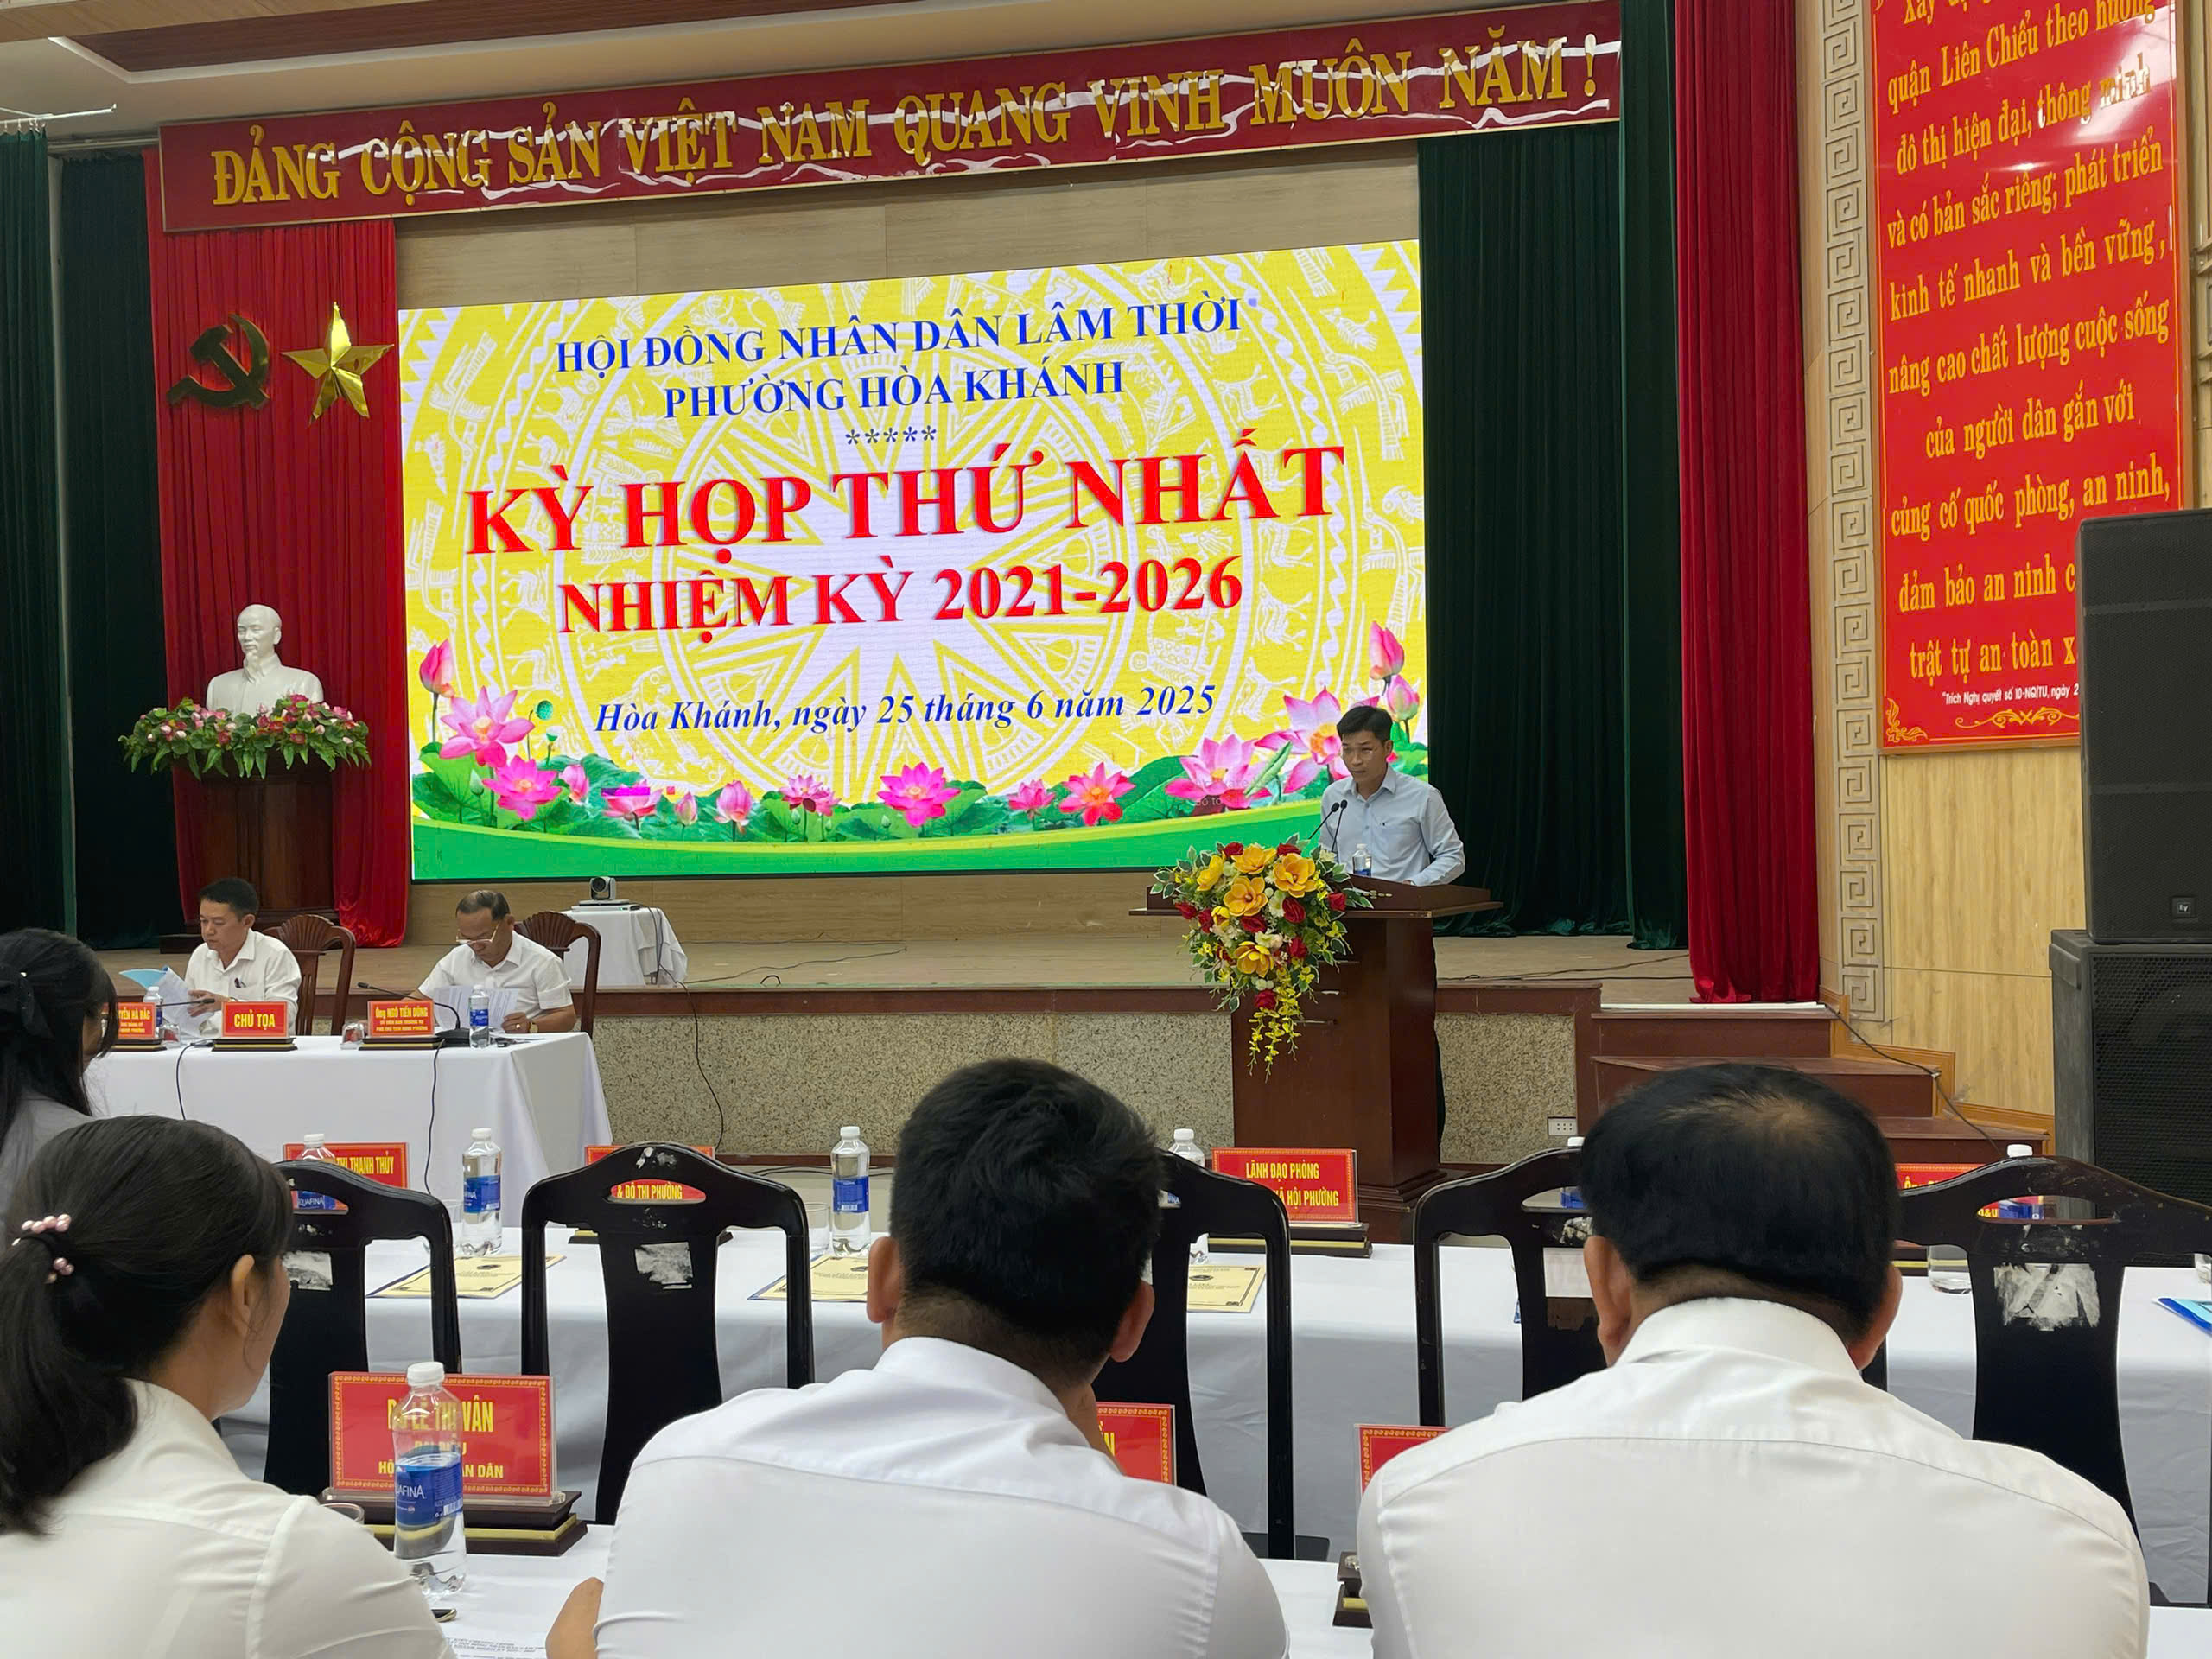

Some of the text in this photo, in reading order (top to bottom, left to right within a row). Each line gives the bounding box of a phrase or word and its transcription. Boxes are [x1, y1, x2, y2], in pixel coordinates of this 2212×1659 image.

[1887, 60, 1931, 115] quận
[1941, 41, 1980, 87] Liên
[1986, 10, 2039, 69] Chiểu
[2046, 3, 2088, 47] theo
[212, 124, 341, 207] ĐẢNG
[360, 120, 493, 207] CỘNG
[508, 101, 603, 183] SẢN
[619, 97, 738, 188] VIỆT
[757, 99, 872, 163] NAM
[893, 81, 1071, 167] QUANG
[1087, 69, 1227, 141] VINH
[1248, 37, 1414, 127] MUÔN
[1897, 53, 2152, 175] đô thị hiện đại, thông minh
[1887, 210, 1906, 249] và
[1910, 202, 1928, 242] có
[1934, 188, 1966, 236] bản
[1972, 173, 2000, 225] sắc
[2064, 146, 2107, 208] phát
[2113, 126, 2164, 184] triển
[1890, 273, 1930, 321] kinh
[1938, 263, 1959, 309] tế
[1963, 248, 2021, 302] nhanh
[2030, 243, 2051, 284] và
[2060, 227, 2097, 276] bền
[555, 290, 1242, 378] HỘI ĐỒNG NHÂN DÂN LÂM THỜI
[1889, 289, 2170, 397] nâng cao chất lượng cuộc sống
[664, 356, 1126, 419] PHƯỜNG HÒA KHÁNH
[1925, 378, 2134, 460] của người dân gắn với
[464, 427, 1345, 565] KỲ HỌP THỨ NHẤT
[1891, 452, 2171, 541] củng cố quốc phòng, an ninh,
[557, 554, 1244, 644] NHIỆM KỲ 2021-2026
[1899, 568, 1936, 613] đảm
[1945, 563, 1975, 608] bảo
[1984, 569, 2005, 602] an
[2013, 553, 2057, 599] ninh
[1910, 628, 2076, 687] trật tự an toàn x
[594, 684, 1217, 735] Hòa Khánh, ngày 25 tháng 6 năm 2025
[2051, 684, 2071, 701] ngày
[234, 1009, 276, 1030] CHỦ TỌA
[651, 1181, 683, 1200] PHƯỜNG
[1246, 1159, 1320, 1182] LÃNH ĐẠO PHÒNG
[1287, 1186, 1301, 1209] HỘI
[1304, 1186, 1339, 1206] PHƯỜNG
[462, 1395, 493, 1432] VÂN
[378, 1460, 395, 1478] HỘ
[477, 1463, 504, 1478] DÂN
[396, 1484, 425, 1499] AFINA
